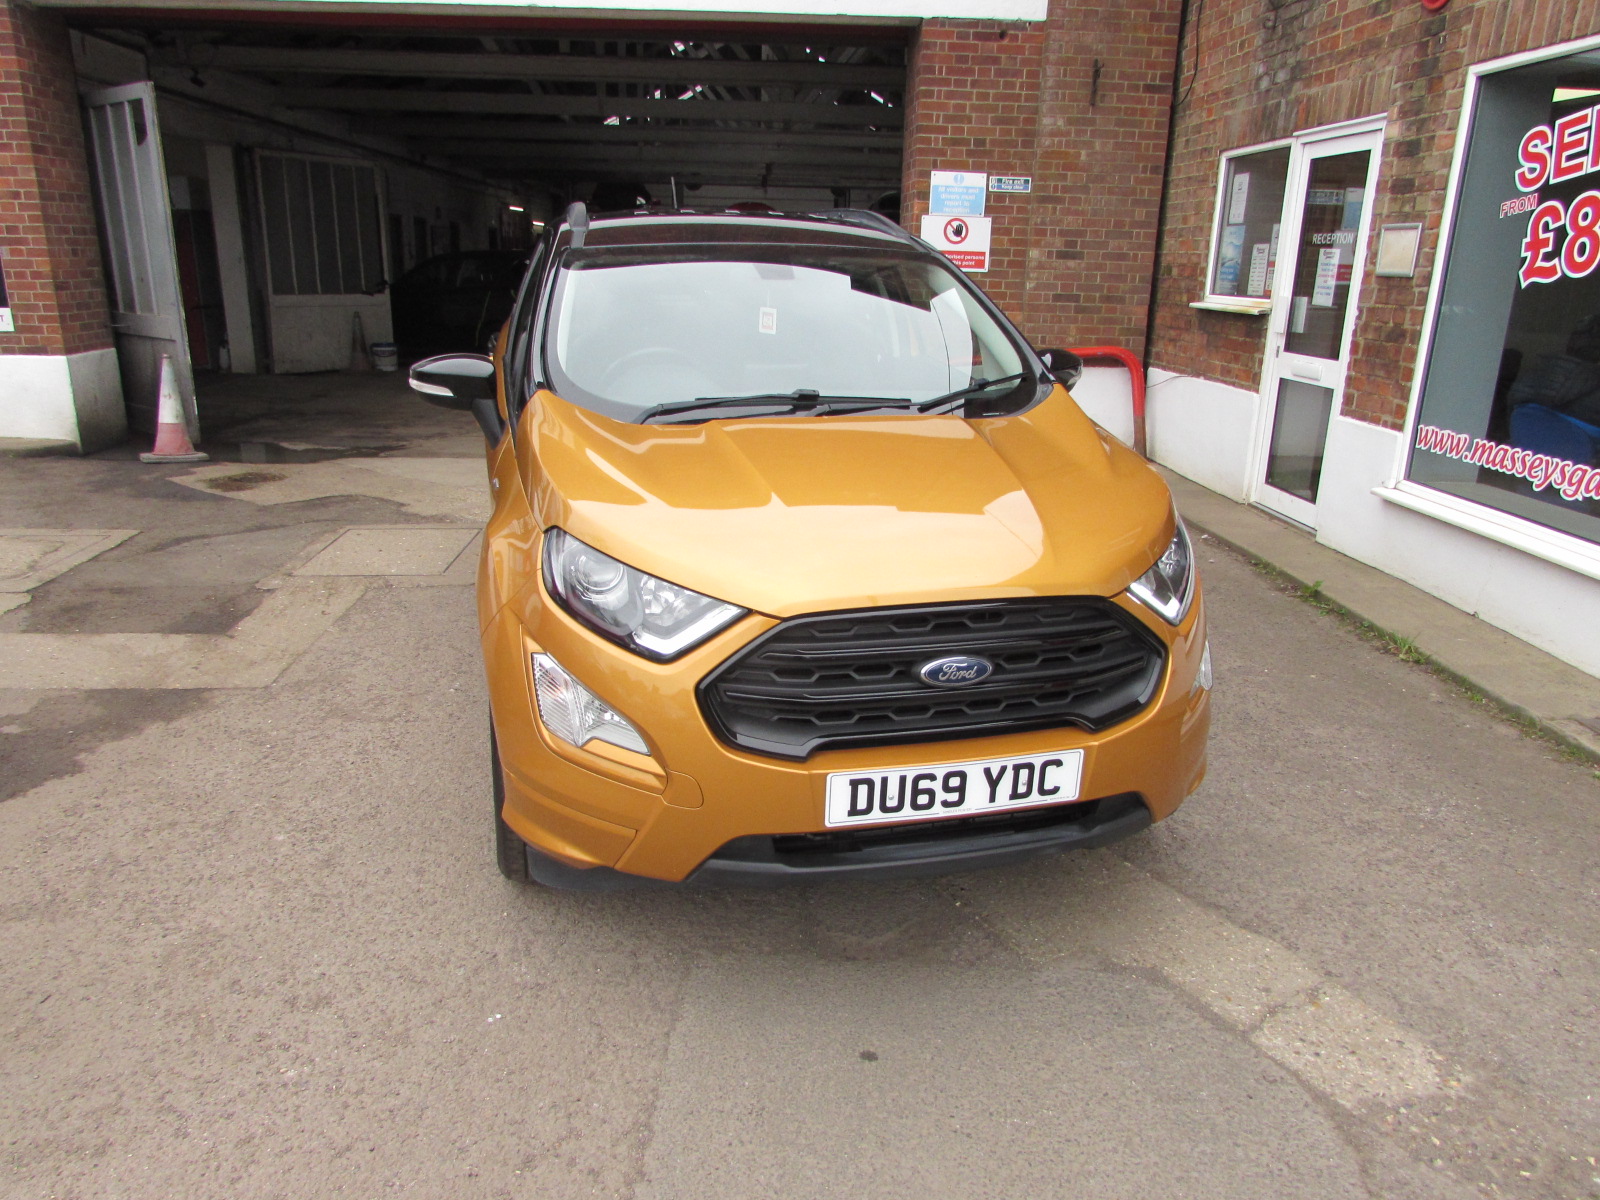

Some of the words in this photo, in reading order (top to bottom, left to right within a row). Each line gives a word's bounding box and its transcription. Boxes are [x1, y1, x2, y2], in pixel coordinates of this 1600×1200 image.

[1500, 193, 1538, 219] FROM
[1312, 232, 1354, 245] RECEPTION
[939, 662, 978, 681] Ford
[847, 770, 968, 818] DU69
[983, 758, 1064, 804] YDC
